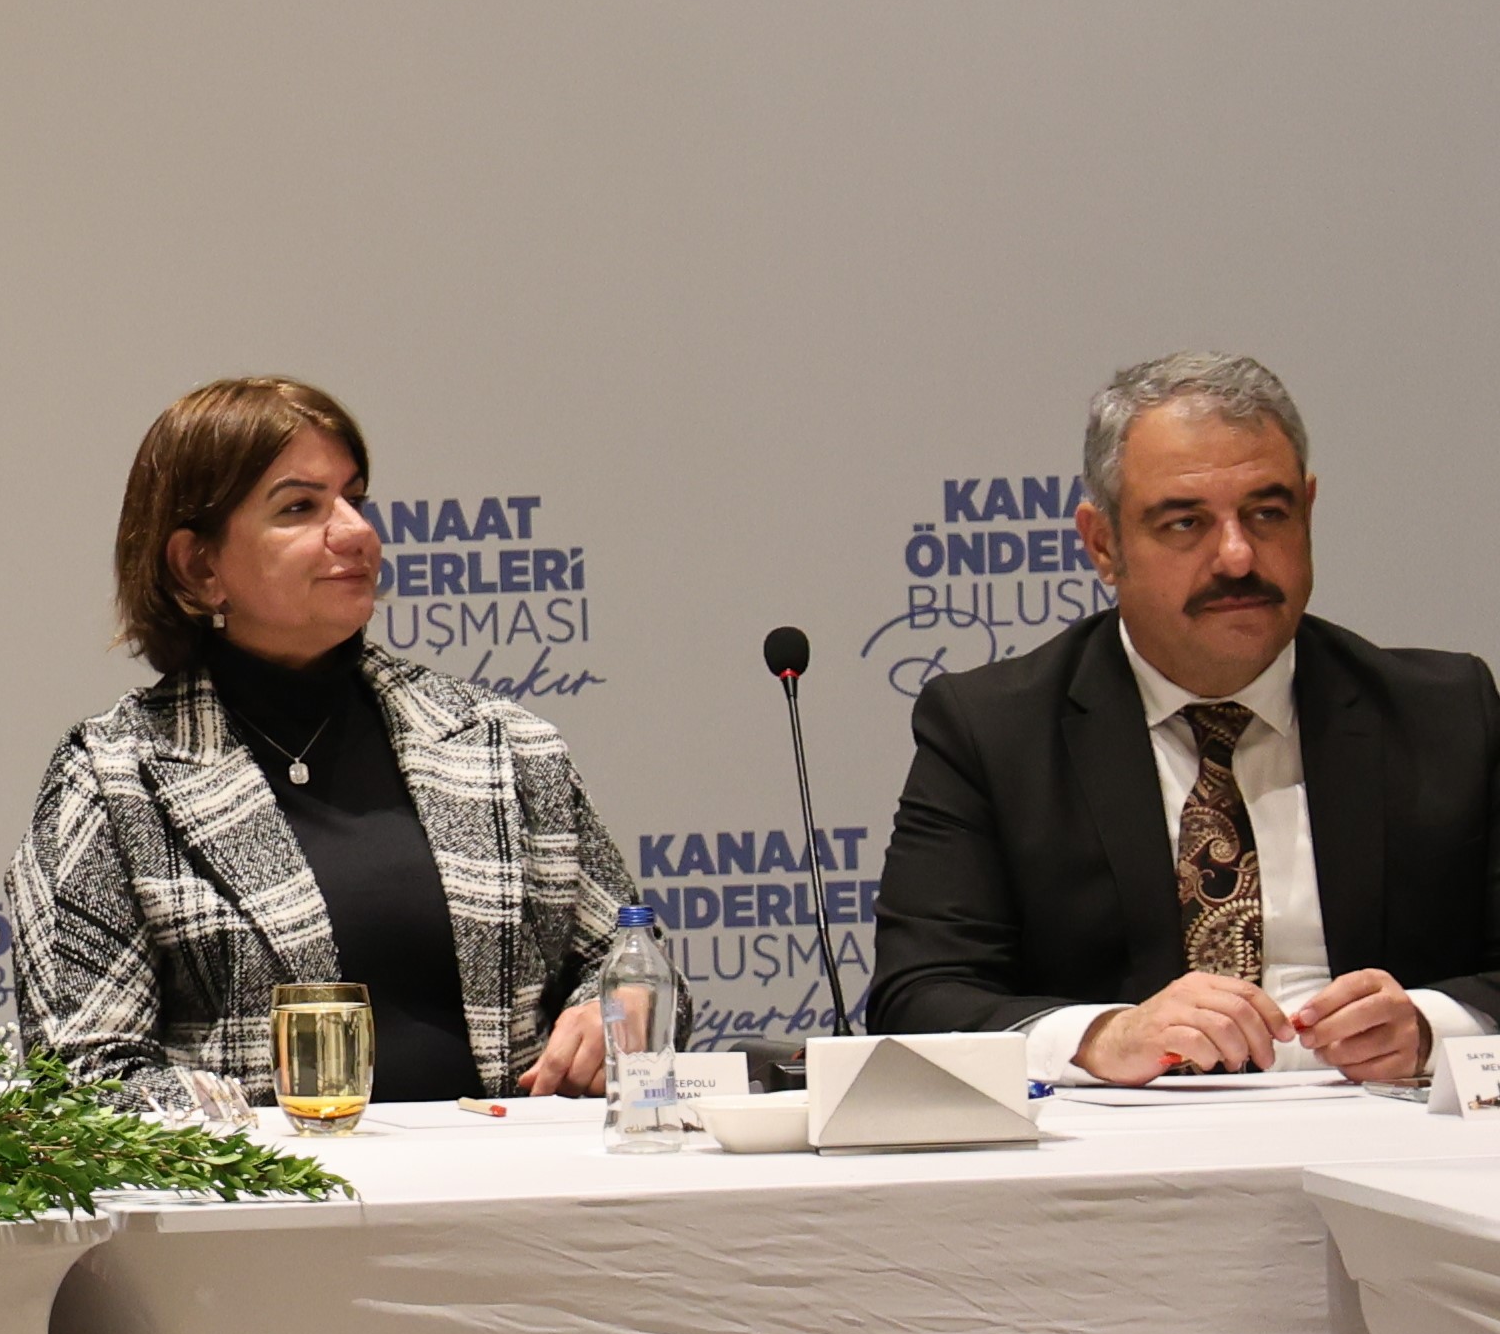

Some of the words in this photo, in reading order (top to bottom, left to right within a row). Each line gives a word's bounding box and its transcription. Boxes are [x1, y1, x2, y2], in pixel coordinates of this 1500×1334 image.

[362, 495, 542, 545] ANAAT
[375, 546, 585, 597] DERLERİ
[905, 523, 1097, 578] ÖNDER
[386, 597, 589, 655] UŞMASI
[467, 646, 606, 700] bakır
[639, 827, 868, 878] KANAAT
